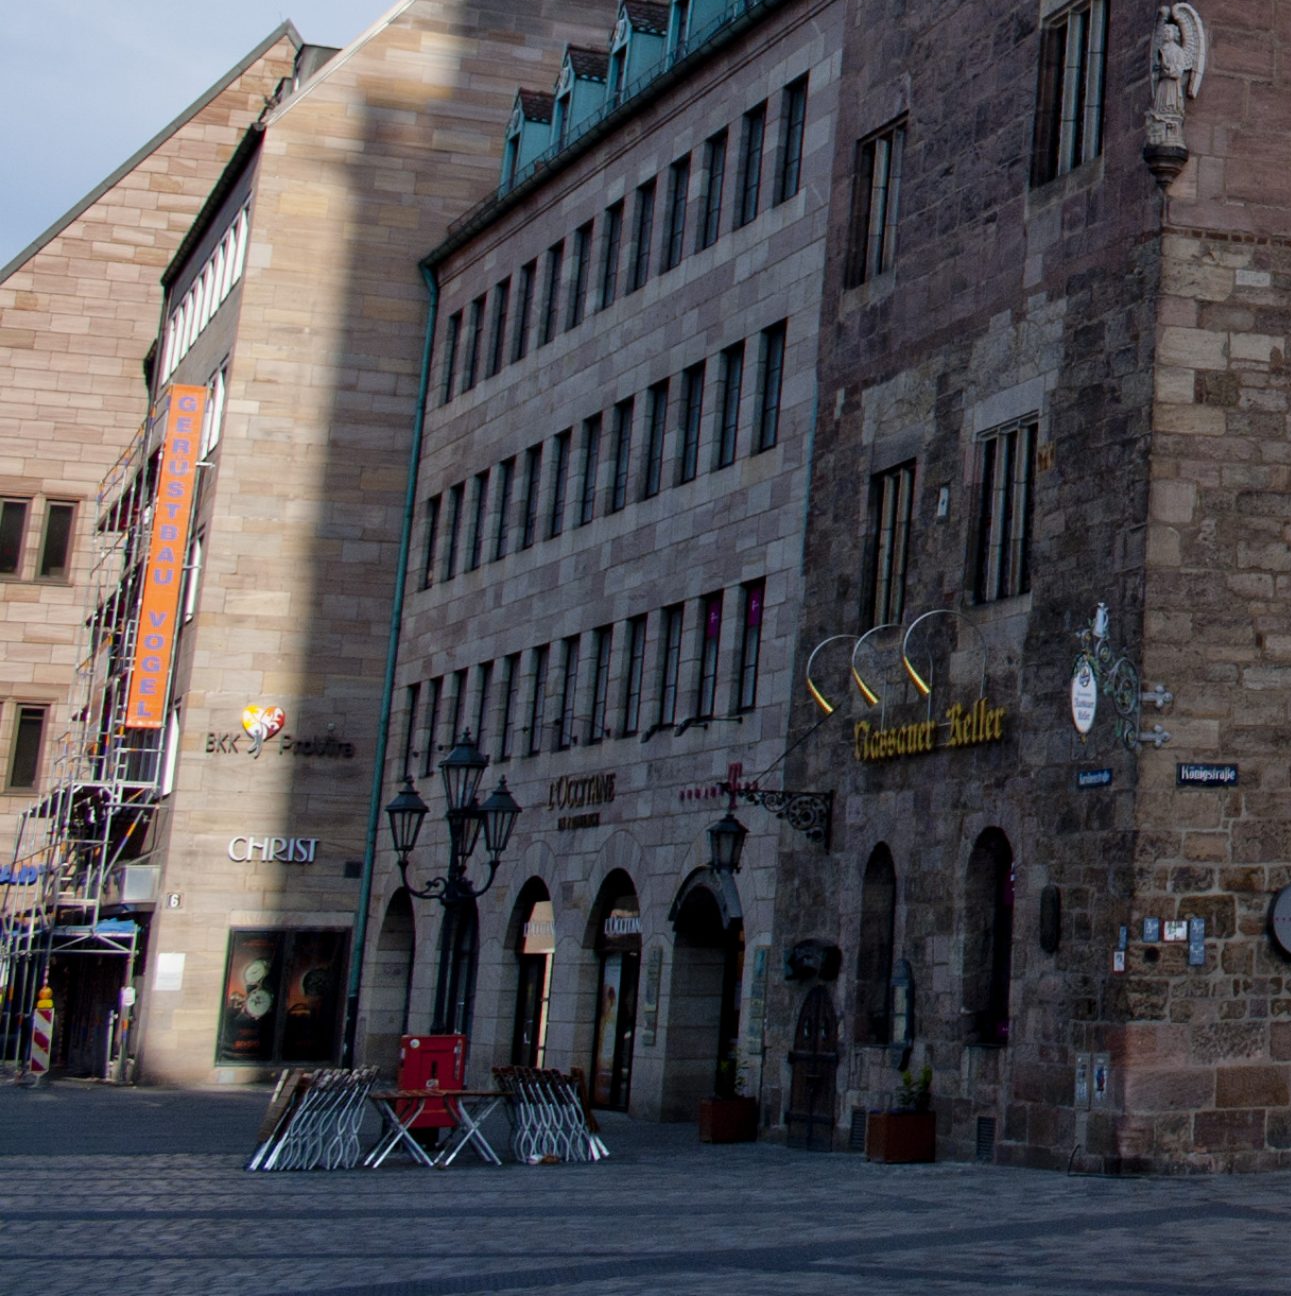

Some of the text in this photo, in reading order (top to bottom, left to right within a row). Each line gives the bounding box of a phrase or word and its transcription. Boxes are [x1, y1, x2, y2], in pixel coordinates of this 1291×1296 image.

[137, 611, 165, 717] VOGEL
[854, 697, 1007, 761] Nassauer Keller
[206, 732, 240, 753] BKK
[1181, 765, 1236, 782] Königstraße
[228, 836, 319, 863] CHRIST
[170, 894, 179, 908] 6
